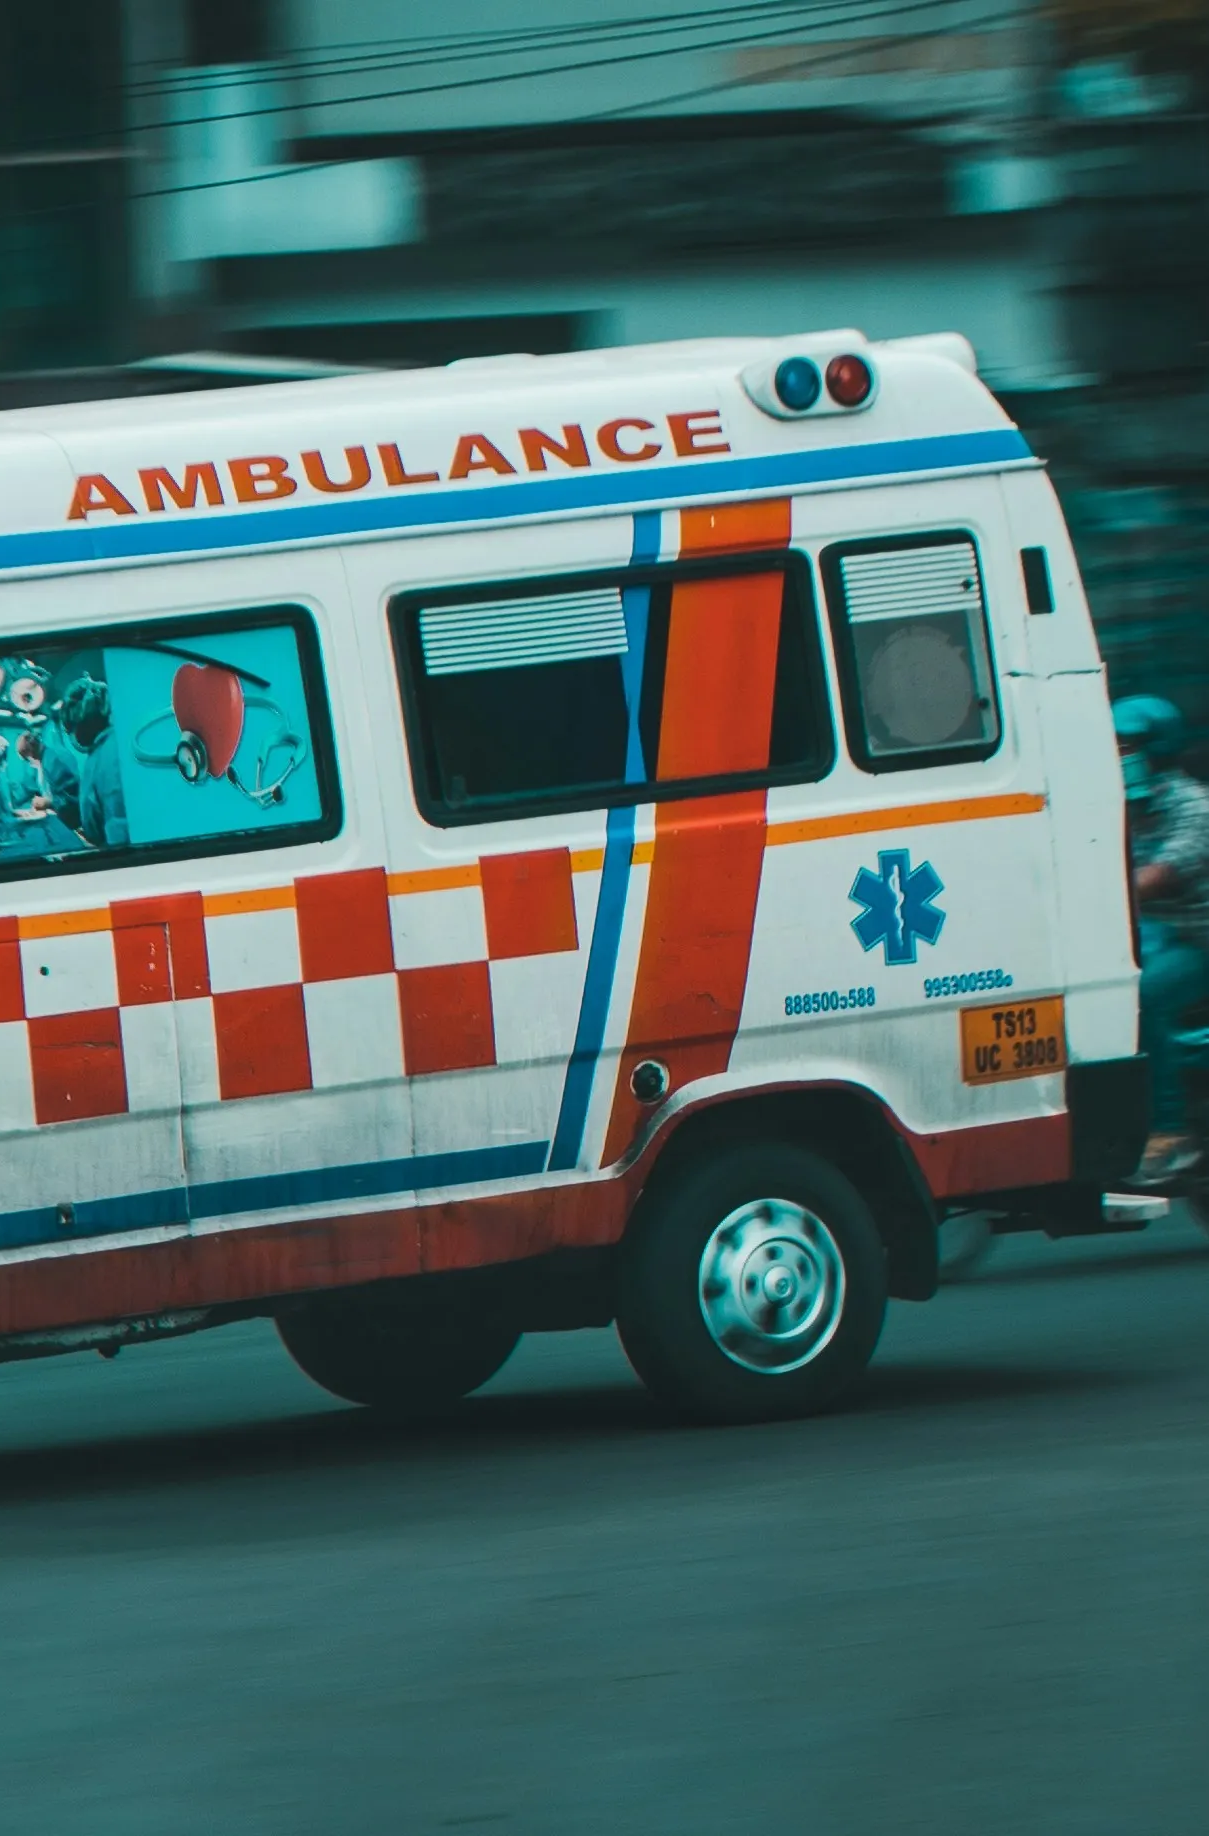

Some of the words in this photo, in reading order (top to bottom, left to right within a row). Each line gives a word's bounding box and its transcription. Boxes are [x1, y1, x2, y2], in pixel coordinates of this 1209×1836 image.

[67, 408, 731, 520] AMBULANCE
[992, 1007, 1036, 1039] TS13
[975, 1043, 1001, 1073] UC
